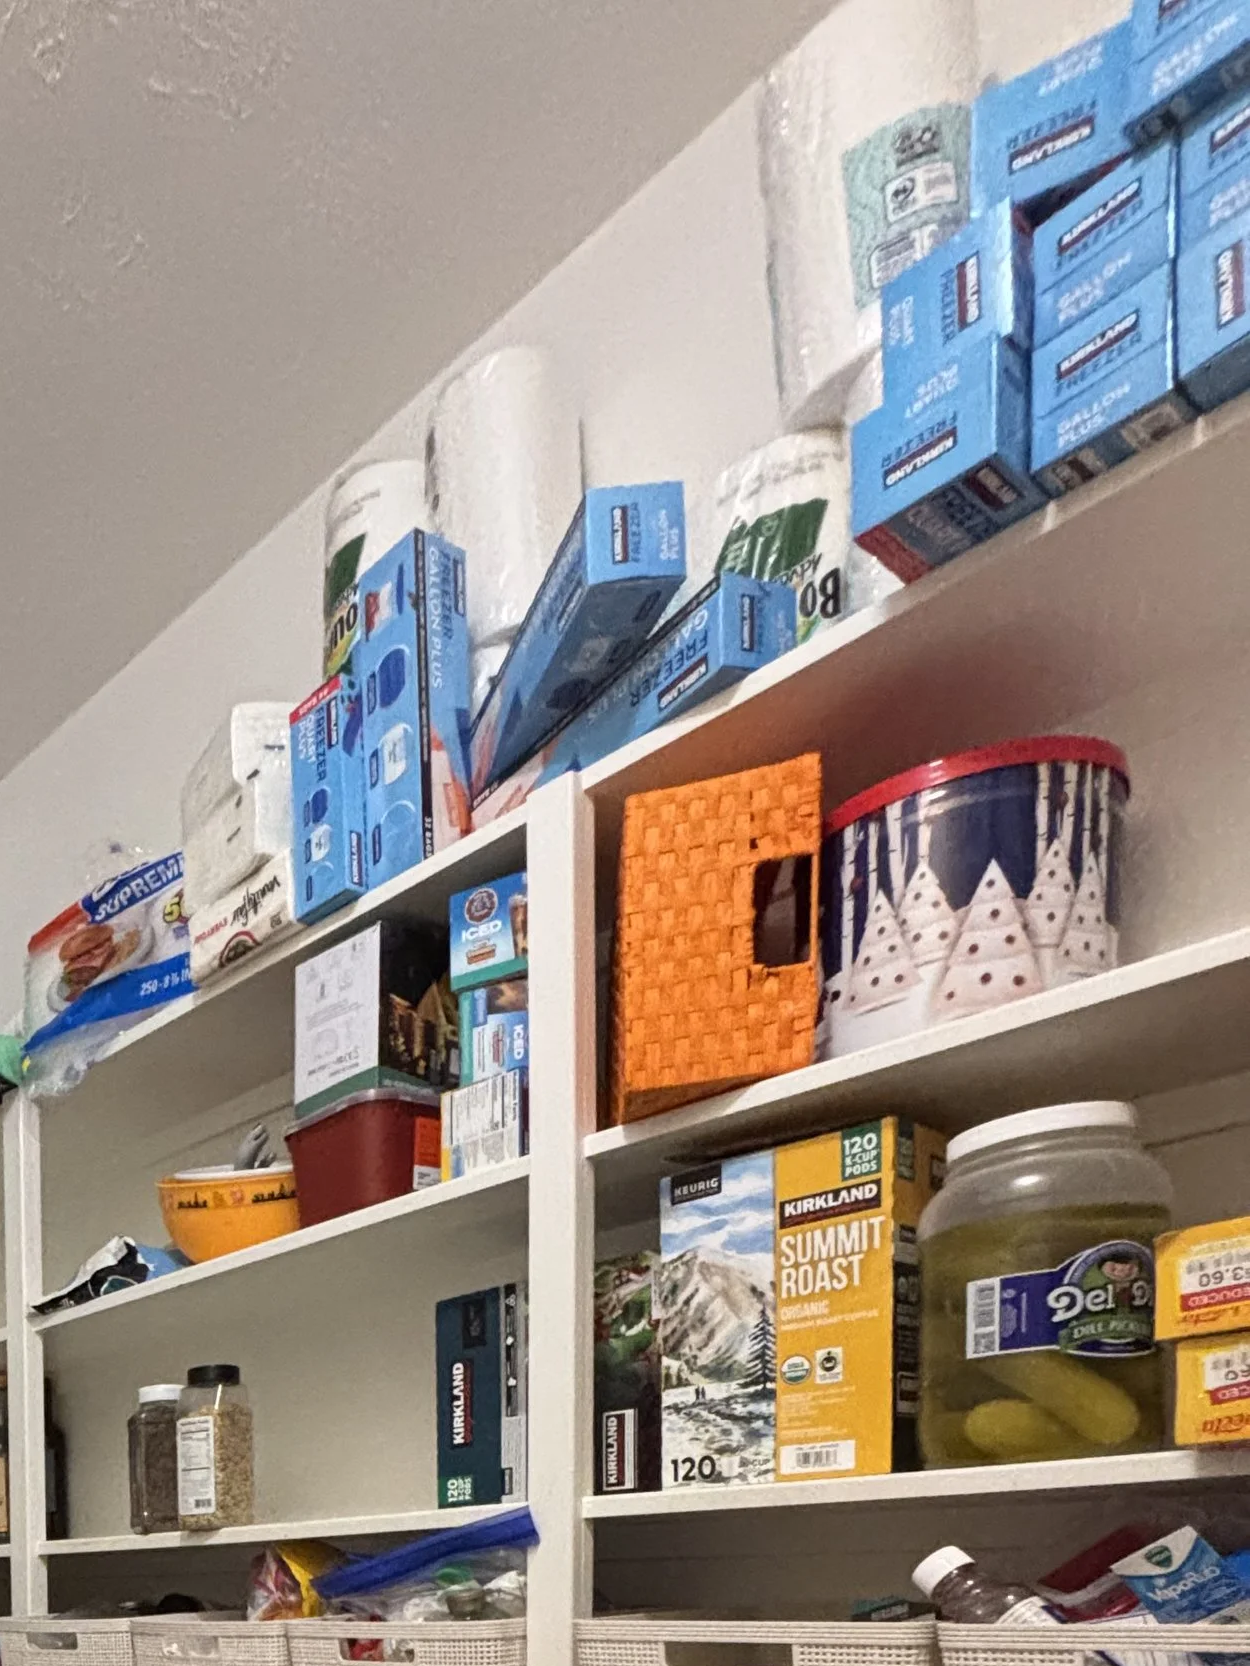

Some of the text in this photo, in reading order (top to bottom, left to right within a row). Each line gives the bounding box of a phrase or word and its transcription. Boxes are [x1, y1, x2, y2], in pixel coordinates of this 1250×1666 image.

[1059, 179, 1140, 247] KIRKLAND
[1059, 310, 1139, 373] KIRKLAND
[884, 435, 955, 488] KIRKLAND
[428, 546, 443, 689] GALLON PLUS
[629, 630, 709, 708] FREEZER
[659, 663, 707, 708] KIRKLAND
[315, 705, 327, 782] FREEZER
[461, 920, 502, 942] ICED
[513, 1023, 524, 1061] ICED
[843, 1132, 878, 1156] 120
[845, 1149, 878, 1166] K-CUP
[674, 1177, 719, 1197] KEURIG
[844, 1160, 878, 1178] PODS
[784, 1183, 878, 1218] KIRKLAND
[781, 1216, 886, 1268] SUMMIT
[781, 1253, 865, 1300] ROAST
[780, 1301, 830, 1321] ORGANIC
[1046, 1284, 1116, 1324] Del
[1071, 1322, 1102, 1339] DILL
[452, 1361, 465, 1446] KIRKLAND
[606, 1416, 618, 1485] KIRKLAND
[670, 1455, 717, 1482] 120
[447, 1478, 458, 1502] 120
